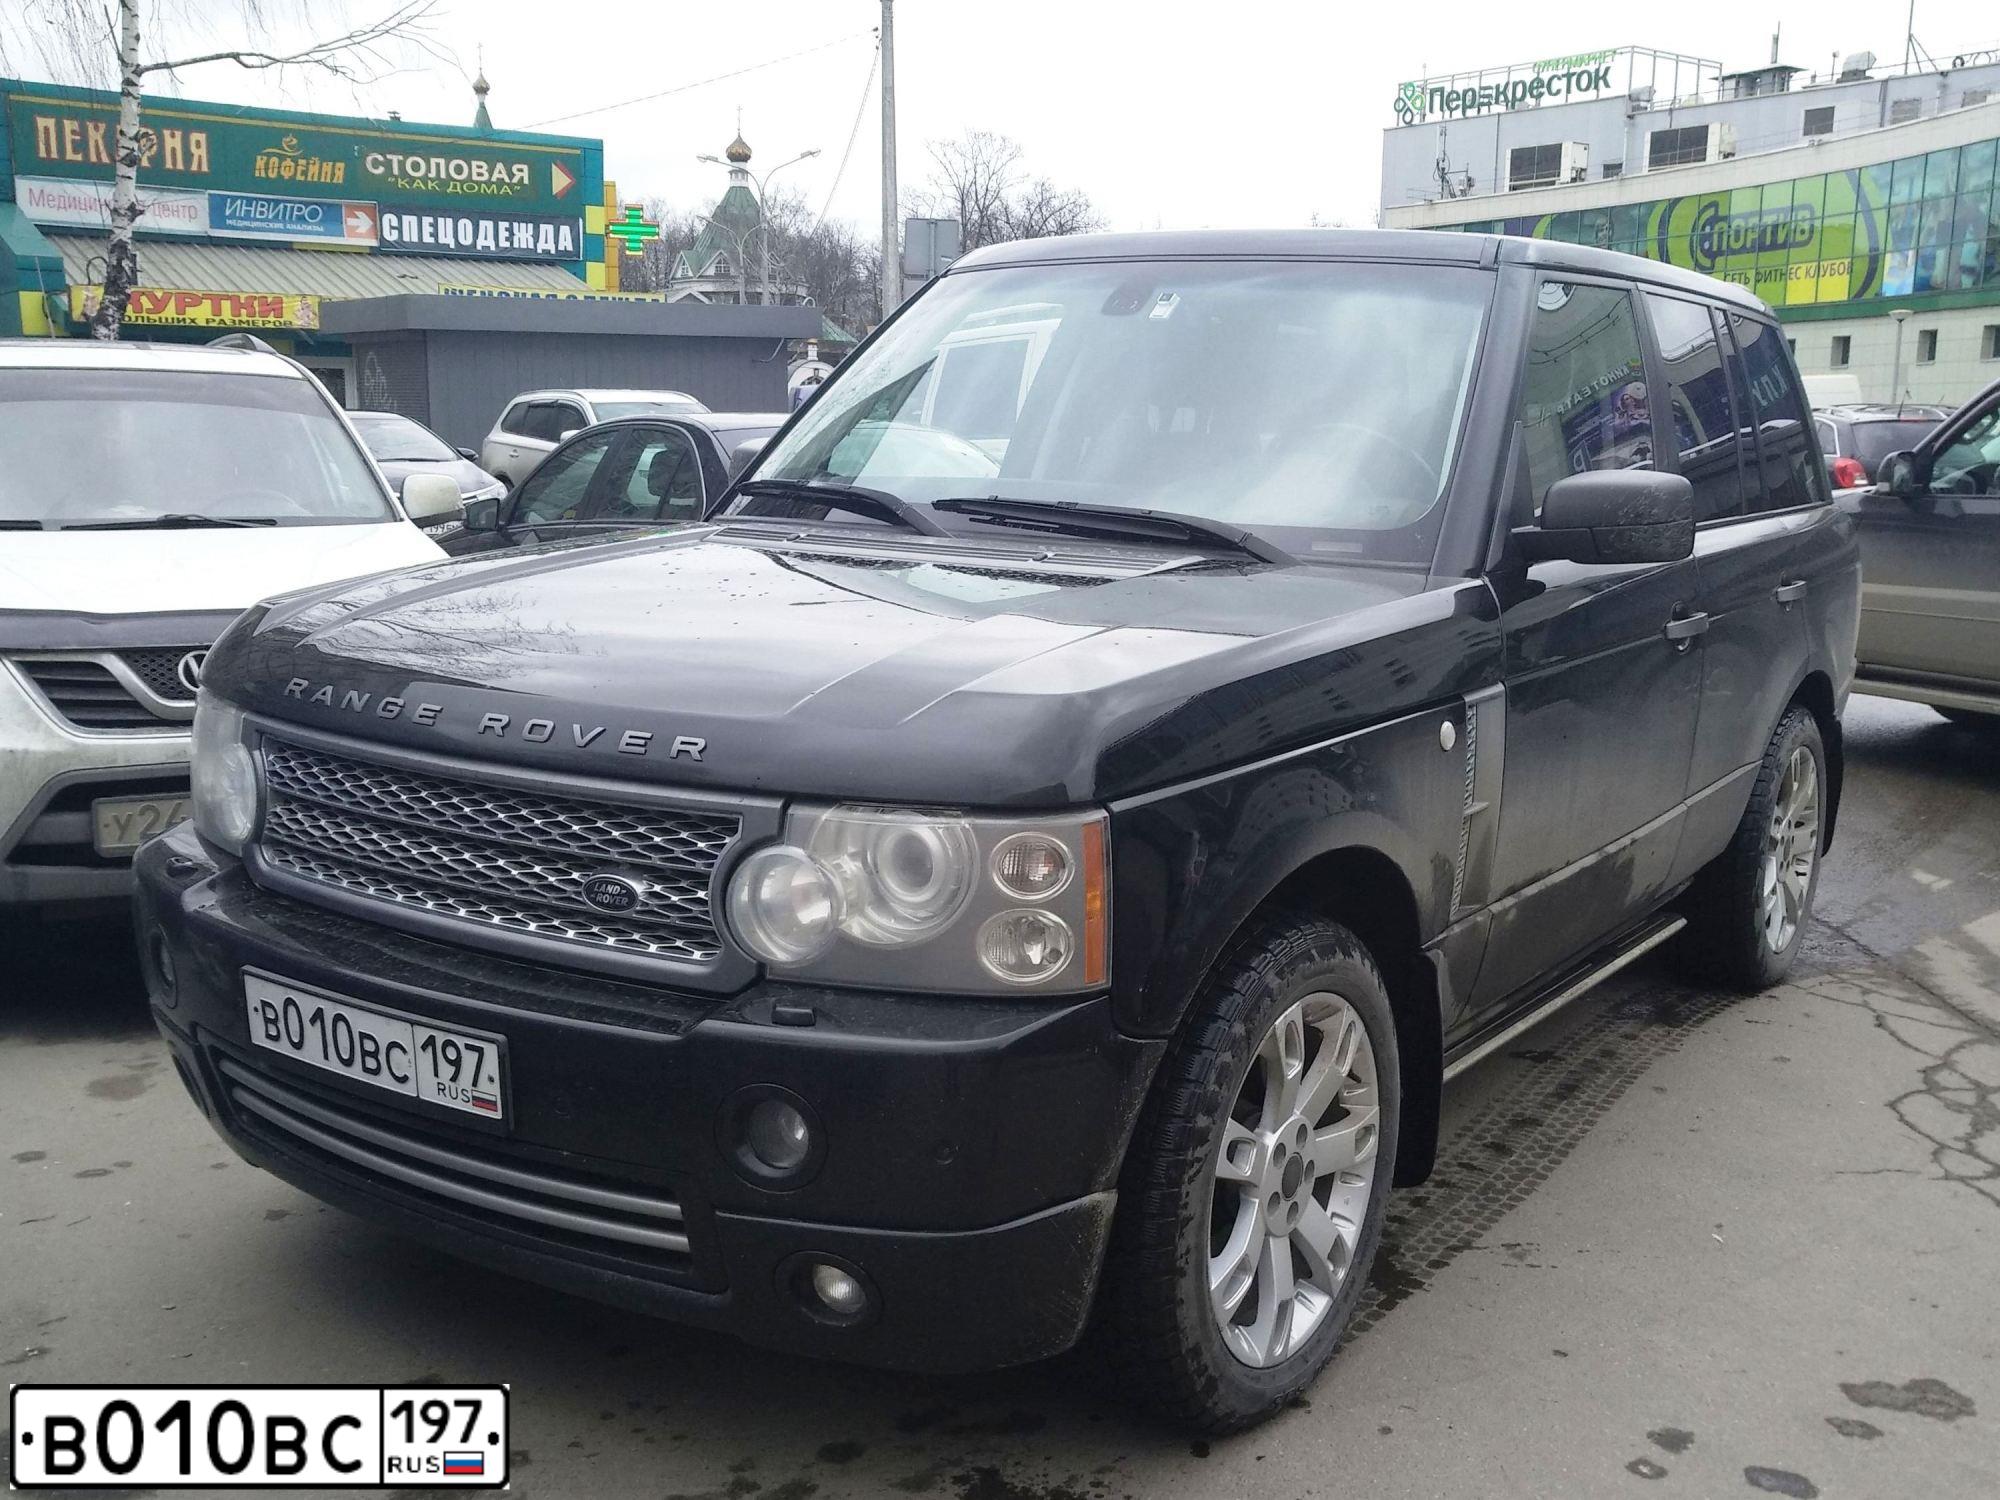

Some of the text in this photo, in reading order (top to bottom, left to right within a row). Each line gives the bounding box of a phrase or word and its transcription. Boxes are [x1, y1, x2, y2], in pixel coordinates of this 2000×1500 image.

[35, 115, 210, 174] ПЕКРНЯ
[254, 155, 345, 184] КОФЕЙНЯ
[365, 153, 529, 185] СТОЛОВАЯ
[225, 198, 323, 223] ИНВИТРО
[381, 213, 574, 254] СПЕЦОДЕЖДА
[1755, 265, 1801, 284] ФИТНЕС
[121, 315, 198, 326] ОЛЬШИХ
[284, 677, 707, 762] RANGE ROVER
[420, 1034, 485, 1088] 197
[436, 1081, 471, 1104] RUS
